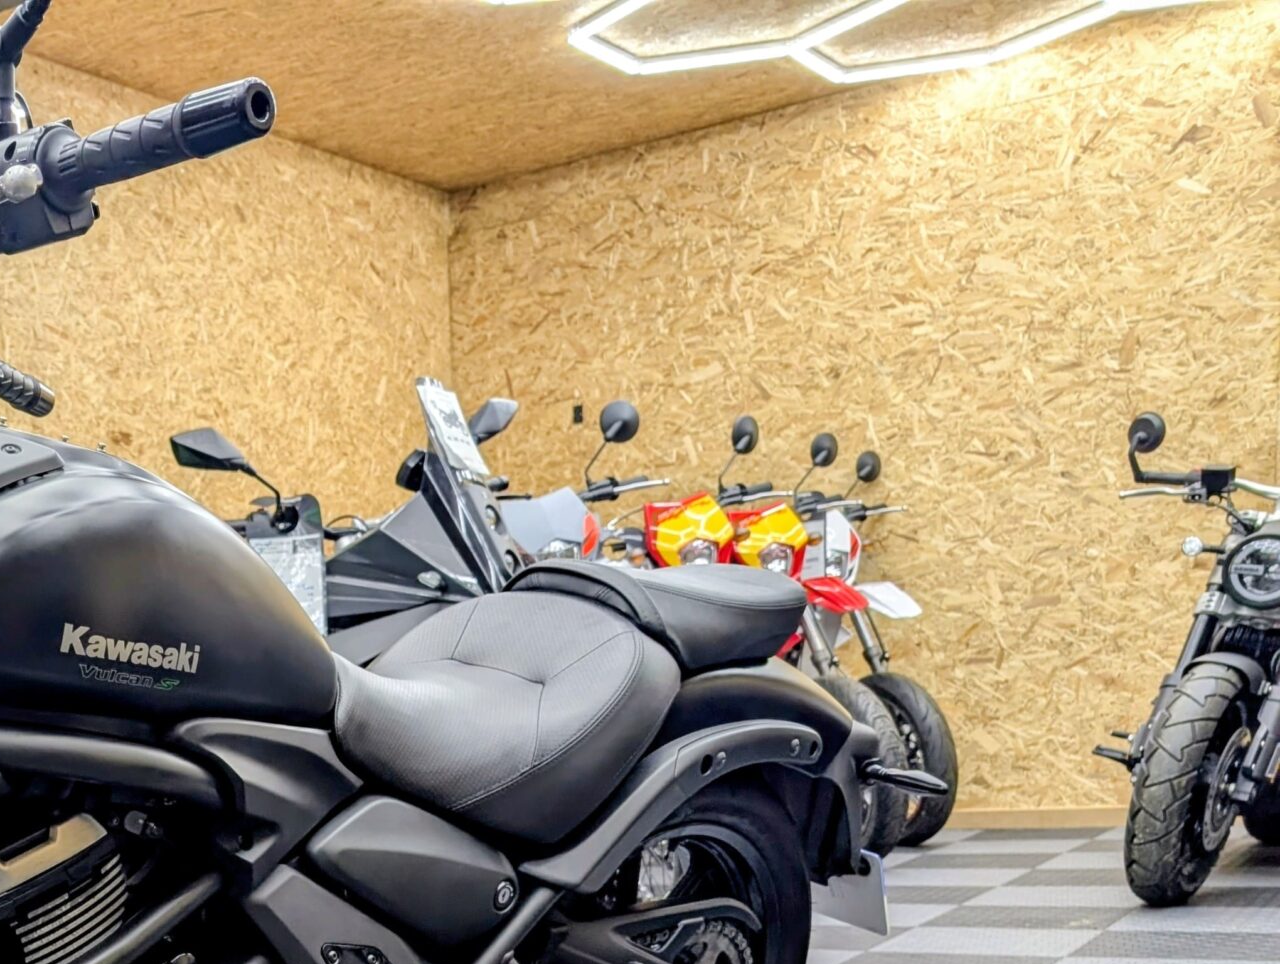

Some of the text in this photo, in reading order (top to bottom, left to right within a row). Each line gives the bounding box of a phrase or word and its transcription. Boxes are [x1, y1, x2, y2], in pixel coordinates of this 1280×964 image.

[59, 622, 201, 674] Kawasaki
[79, 663, 181, 690] Vulcan S
